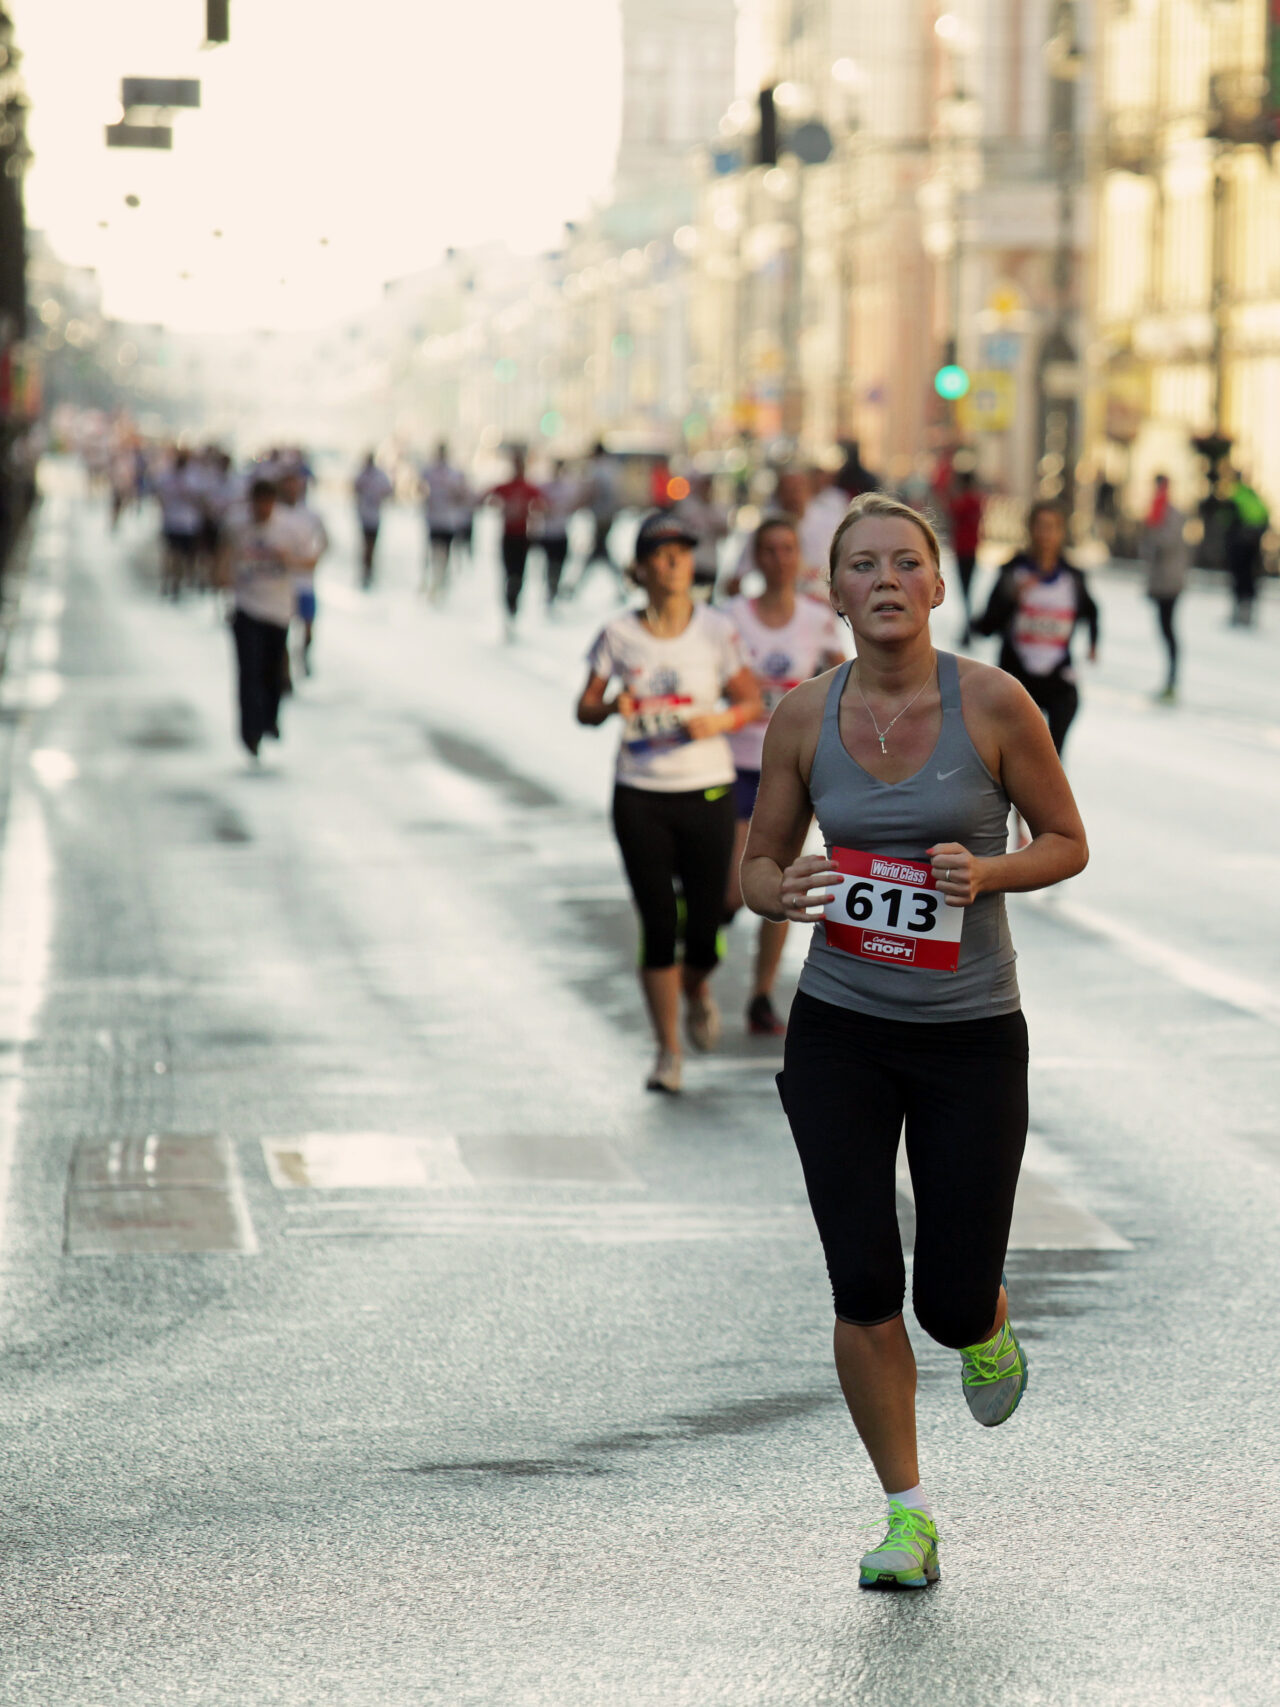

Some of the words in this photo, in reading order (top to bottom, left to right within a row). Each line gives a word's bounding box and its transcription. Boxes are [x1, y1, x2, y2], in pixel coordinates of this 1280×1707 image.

[872, 861, 900, 878] World
[899, 866, 925, 883] Class
[846, 882, 938, 932] 613
[863, 941, 913, 957] СПОРТ
